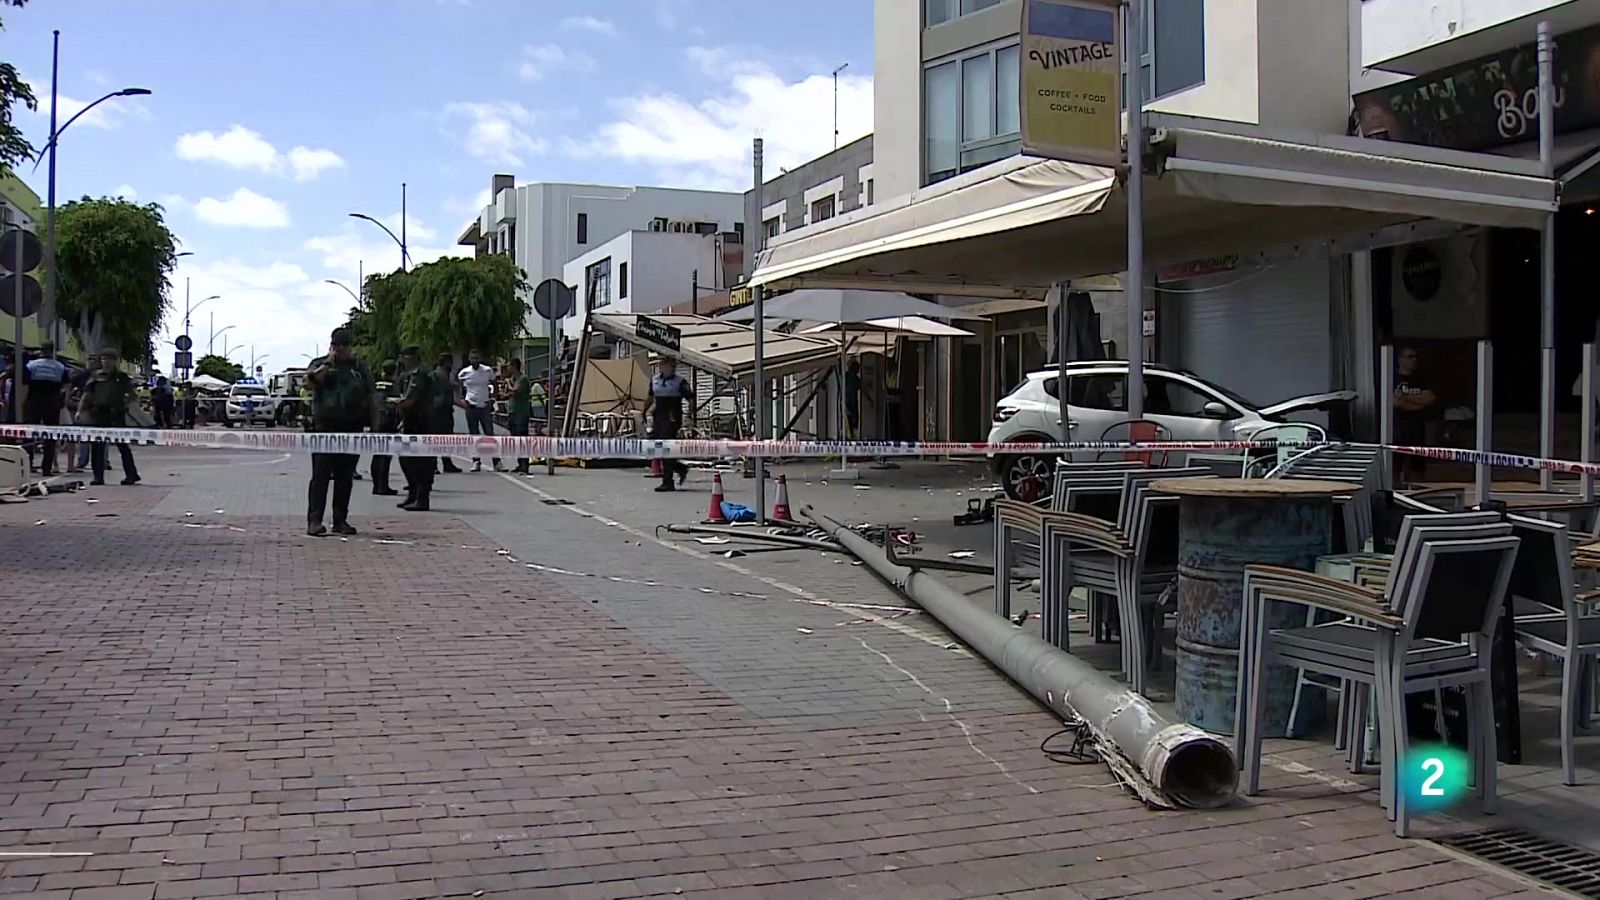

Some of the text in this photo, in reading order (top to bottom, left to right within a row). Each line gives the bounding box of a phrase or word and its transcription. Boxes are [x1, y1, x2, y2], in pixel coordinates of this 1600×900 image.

[1038, 89, 1106, 103] COFFEE FOOD
[1050, 103, 1096, 114] COCKTAILS
